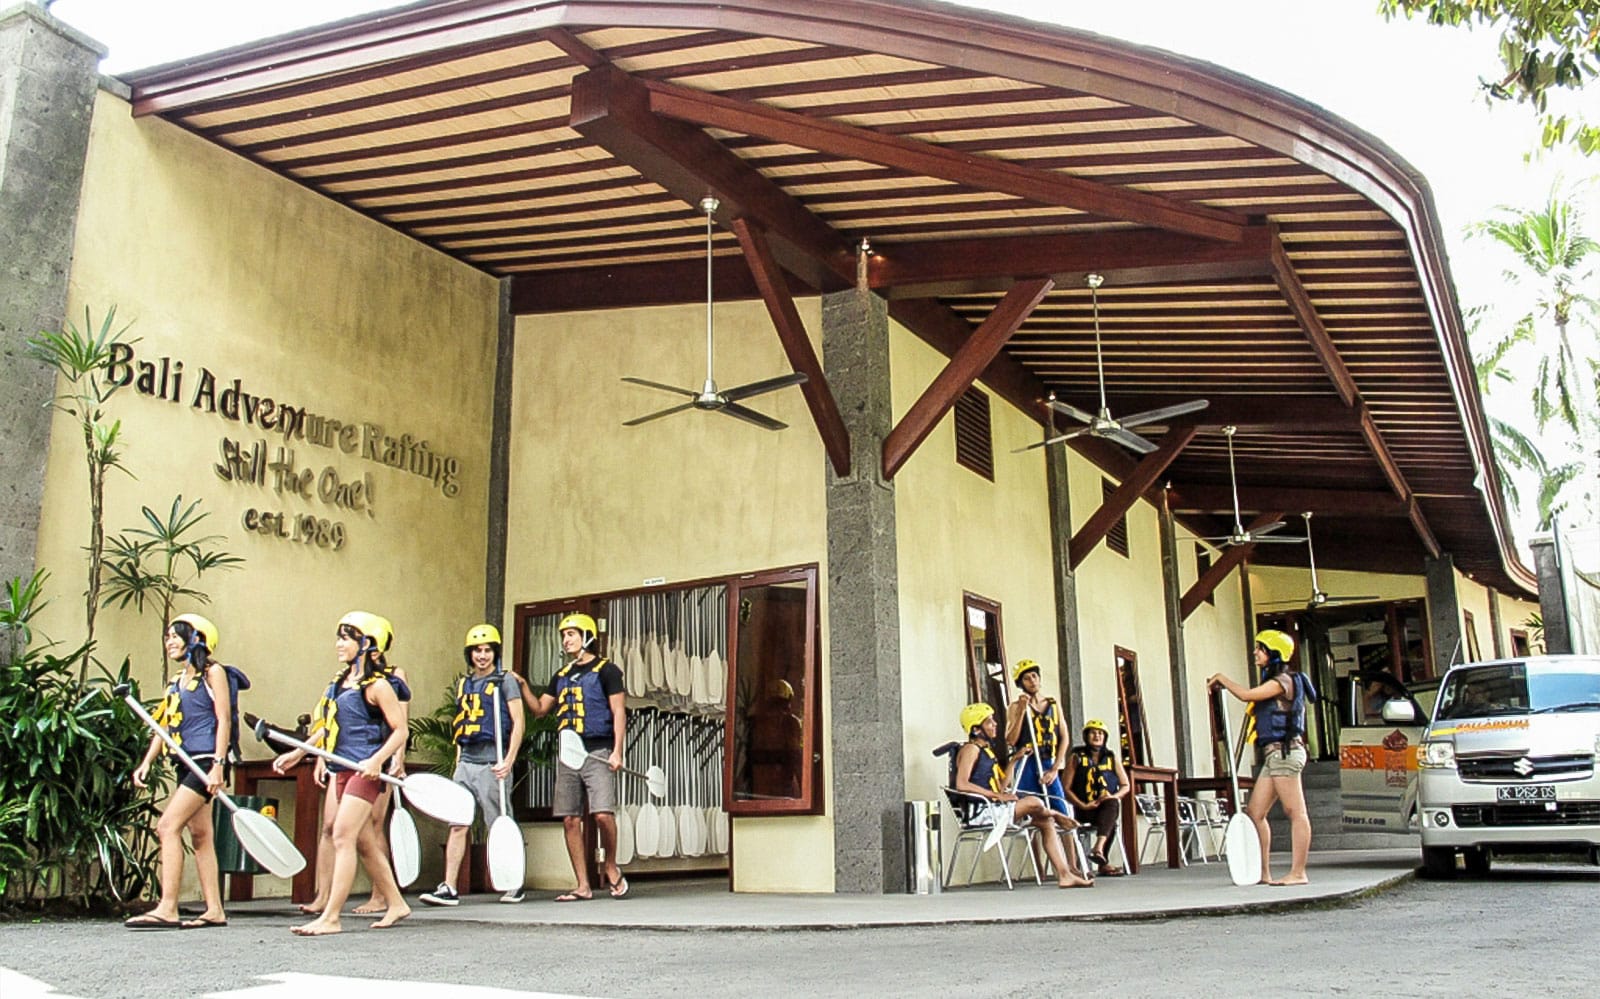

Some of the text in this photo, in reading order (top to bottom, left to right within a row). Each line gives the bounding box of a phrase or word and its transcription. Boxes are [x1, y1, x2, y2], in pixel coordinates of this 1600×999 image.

[102, 342, 461, 498] Bali Adventure Rafting
[214, 437, 375, 519] Still the One!
[290, 512, 346, 551] 1989
